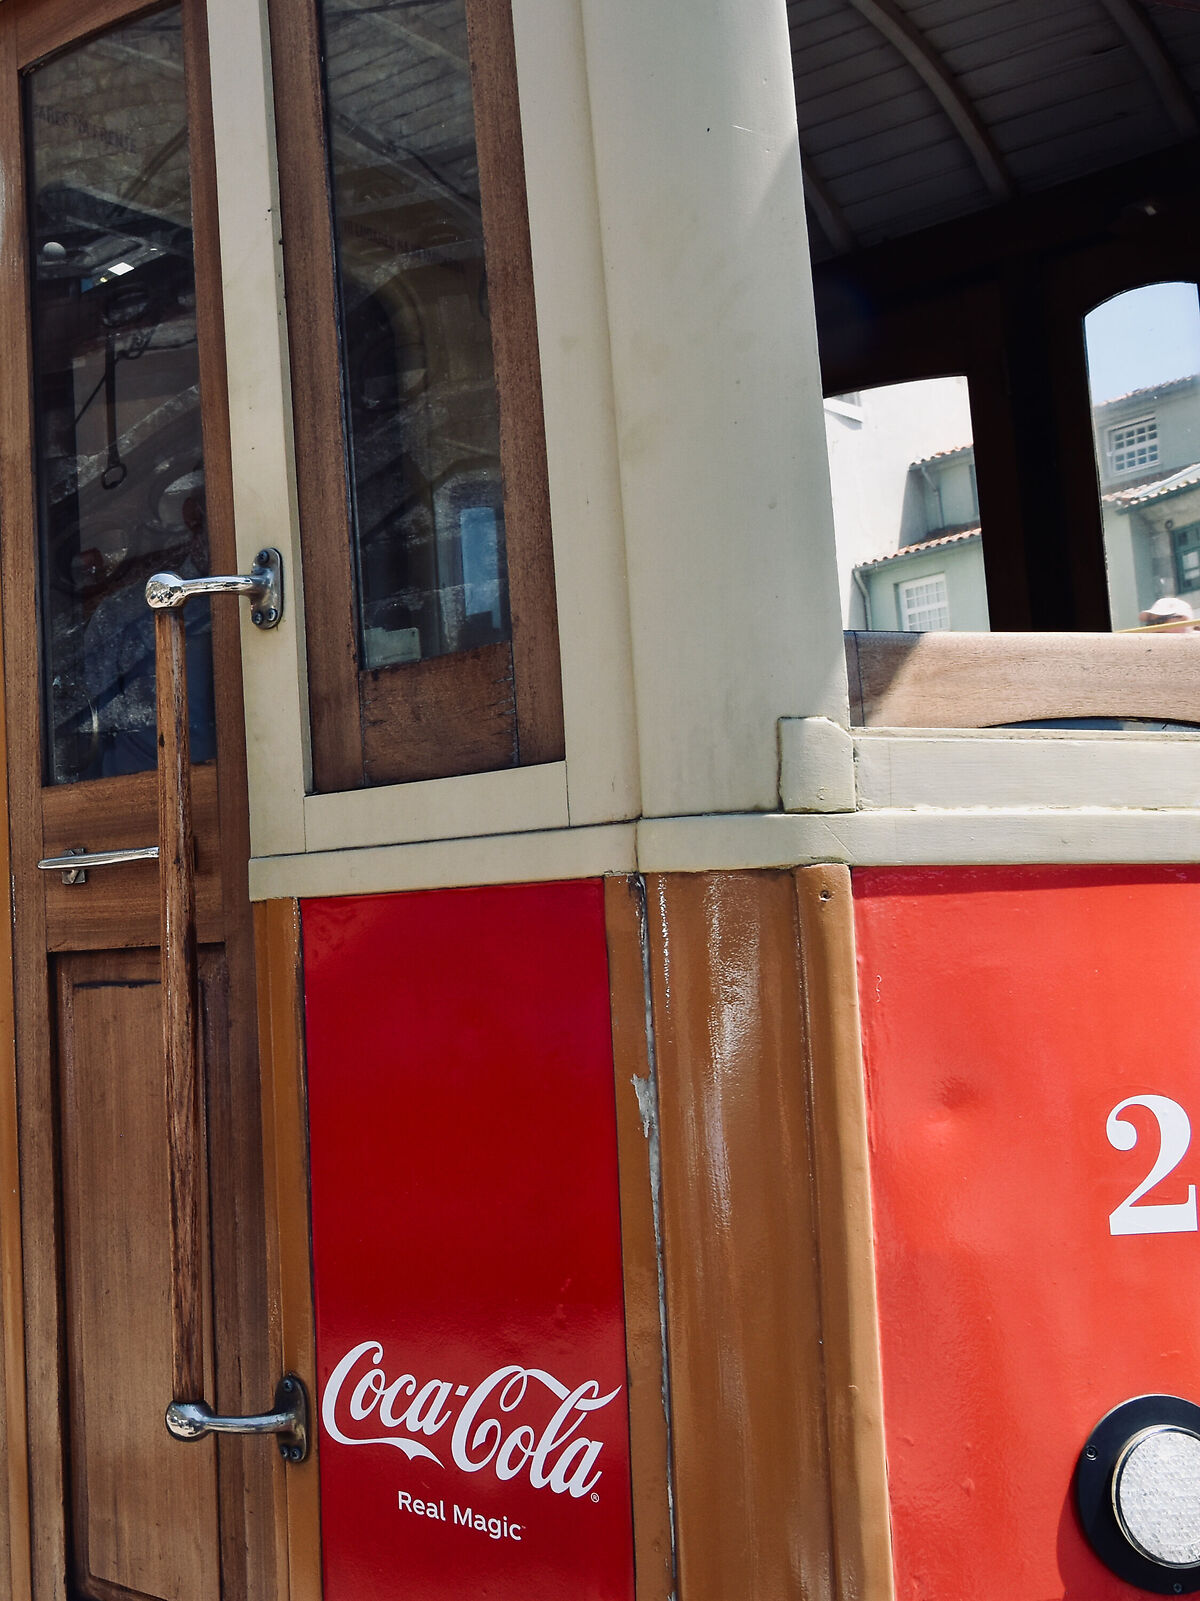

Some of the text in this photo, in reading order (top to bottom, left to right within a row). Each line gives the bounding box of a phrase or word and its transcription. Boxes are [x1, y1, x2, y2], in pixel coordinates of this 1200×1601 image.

[1106, 1094, 1198, 1236] 2
[322, 1340, 622, 1498] Coca-Cola
[398, 1490, 522, 1541] Real Magic
